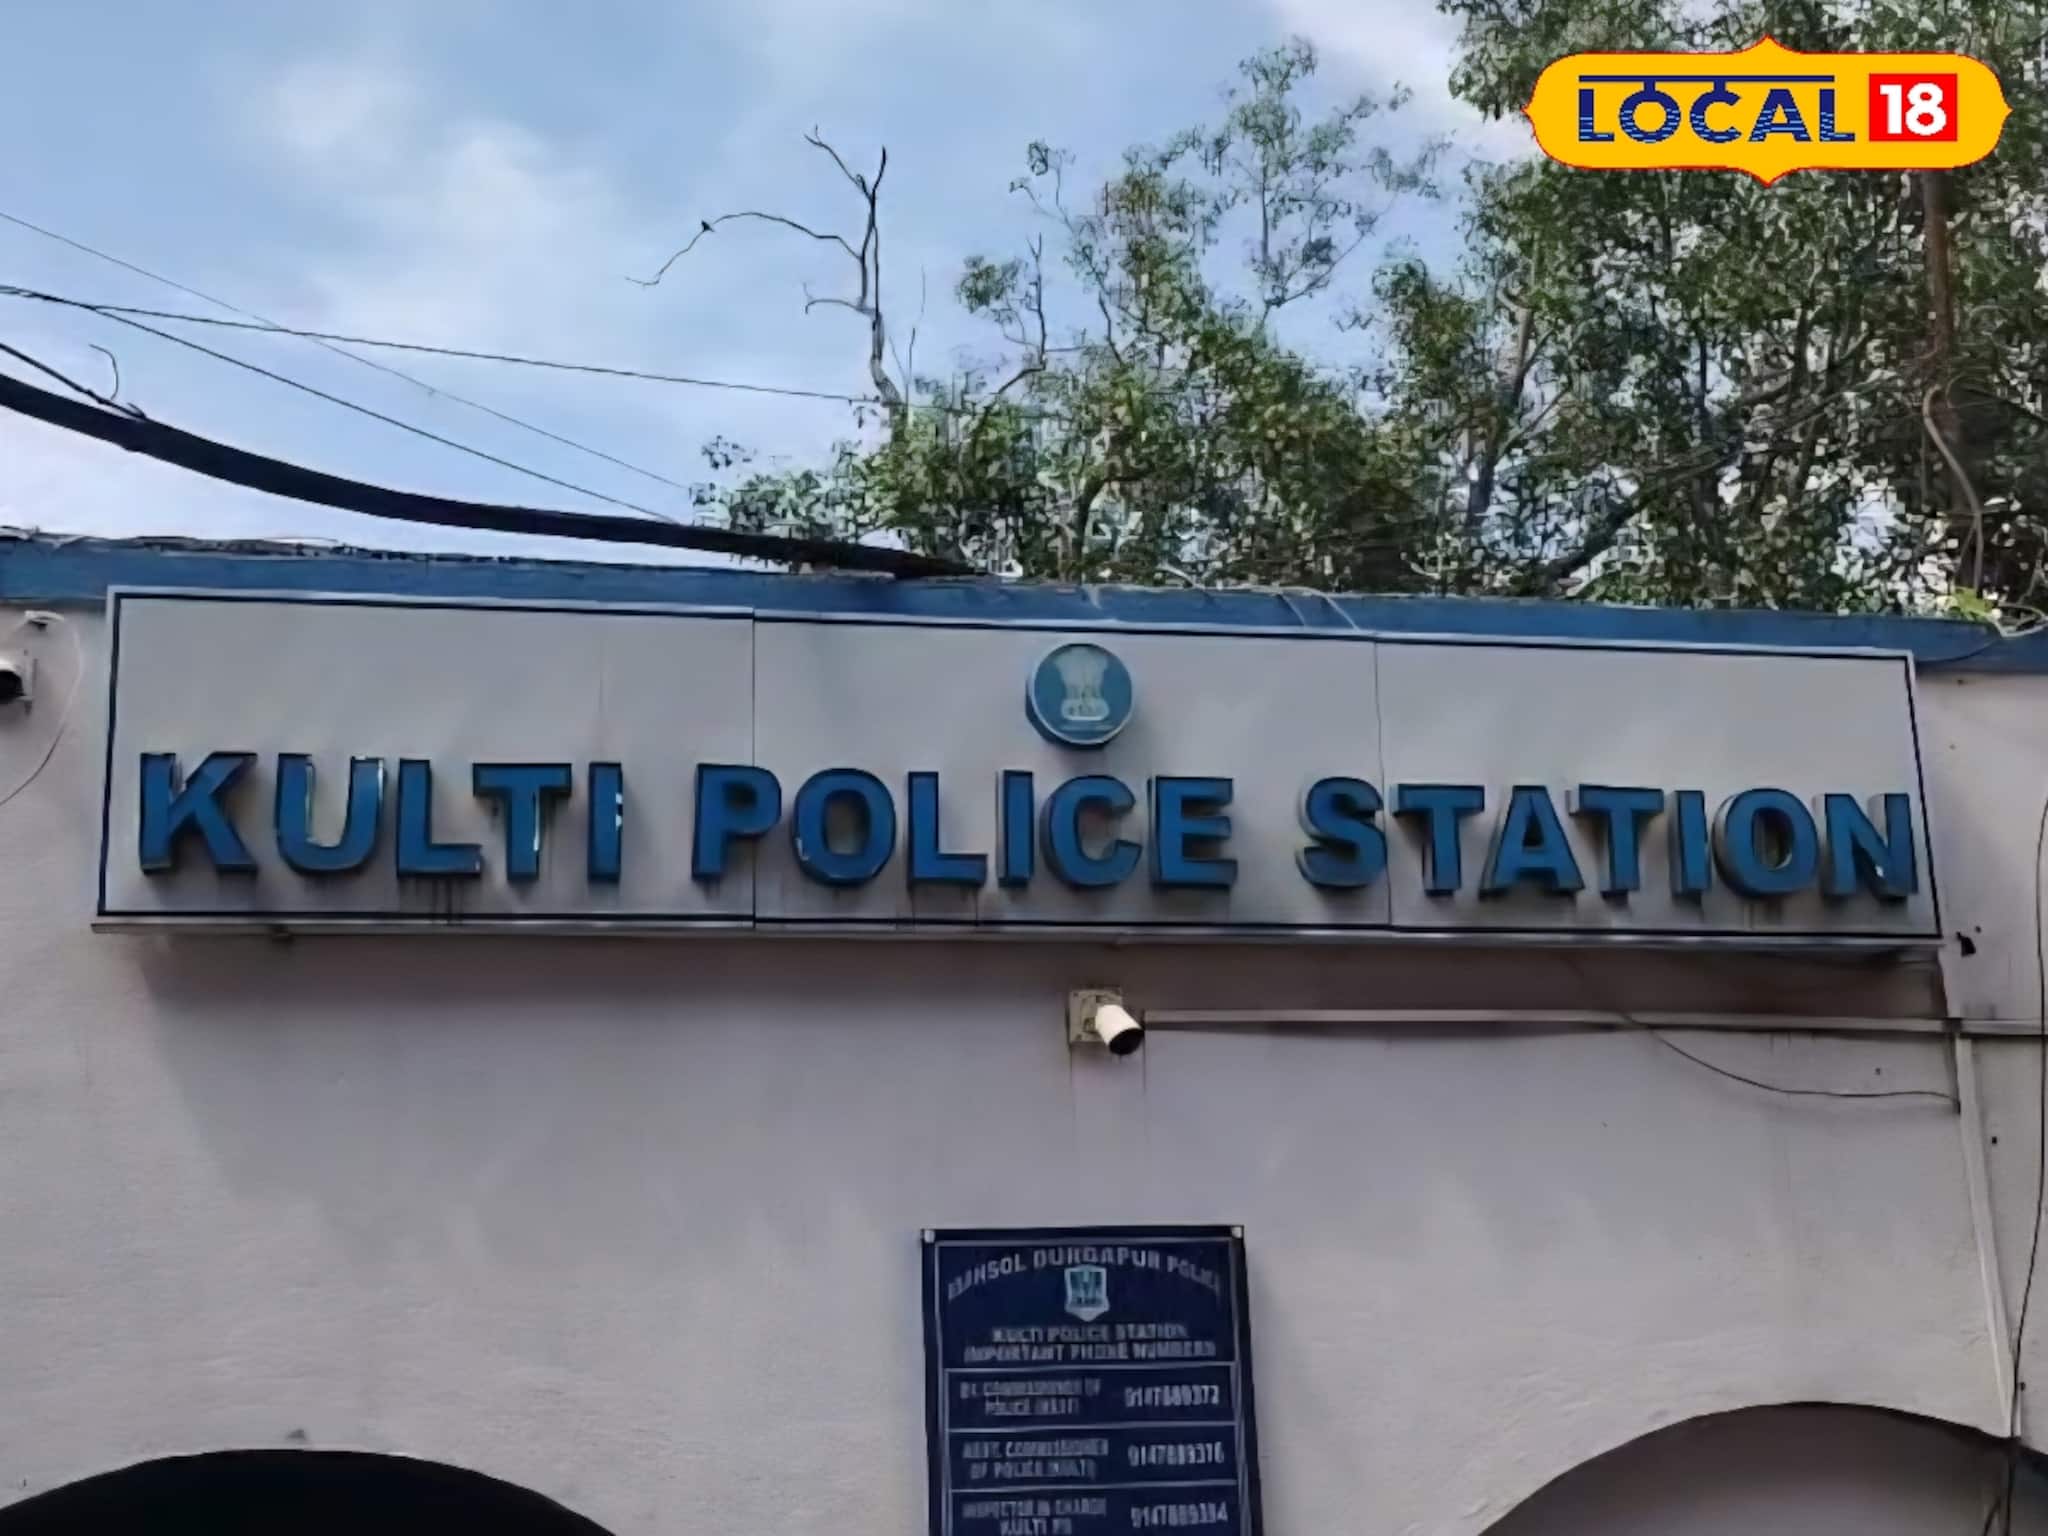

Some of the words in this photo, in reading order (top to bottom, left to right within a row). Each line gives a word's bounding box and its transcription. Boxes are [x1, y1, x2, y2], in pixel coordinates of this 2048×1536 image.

[139, 752, 623, 883] KULTI
[692, 763, 1238, 890] POLICE
[1297, 777, 1918, 899] STATION
